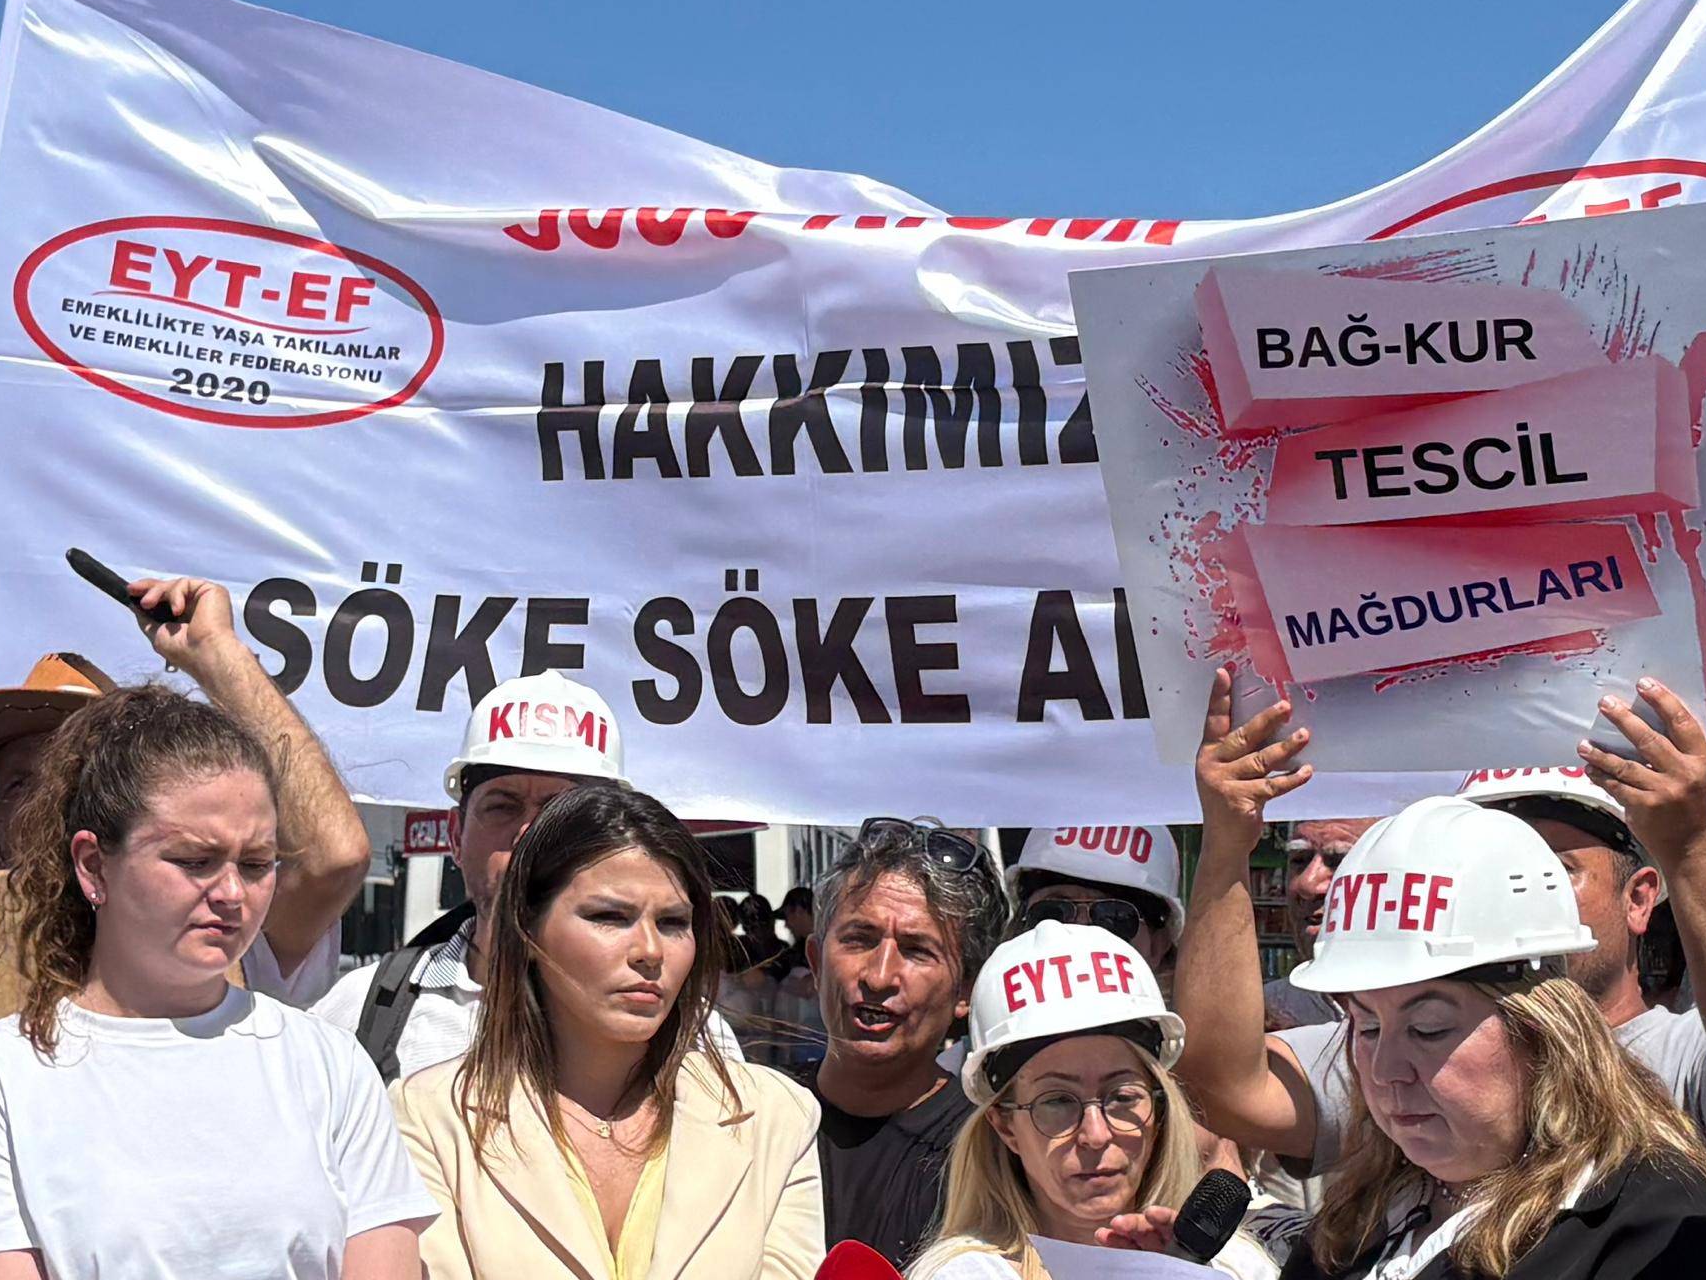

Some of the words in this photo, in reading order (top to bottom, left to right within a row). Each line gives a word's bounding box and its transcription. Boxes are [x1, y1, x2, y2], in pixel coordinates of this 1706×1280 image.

[109, 239, 376, 323] EYT-EF
[61, 297, 205, 336] EMEKLİLİKTE
[212, 325, 266, 347] YAŞA
[273, 334, 401, 360] TAKILANLAR
[69, 324, 96, 341] VE
[102, 330, 223, 364] EMEKLİLER
[229, 353, 383, 384] FEDERASYONU
[1255, 314, 1537, 370] BAĞ-KUR
[169, 367, 271, 405] 2020
[1315, 422, 1588, 501] TESCİL
[1285, 555, 1626, 650] MAĞDURLARI
[243, 561, 590, 712] SÖKE
[631, 568, 972, 725] SÖKE
[1326, 873, 1453, 932] EYT-EF
[1003, 952, 1134, 1013] EYT-EF
